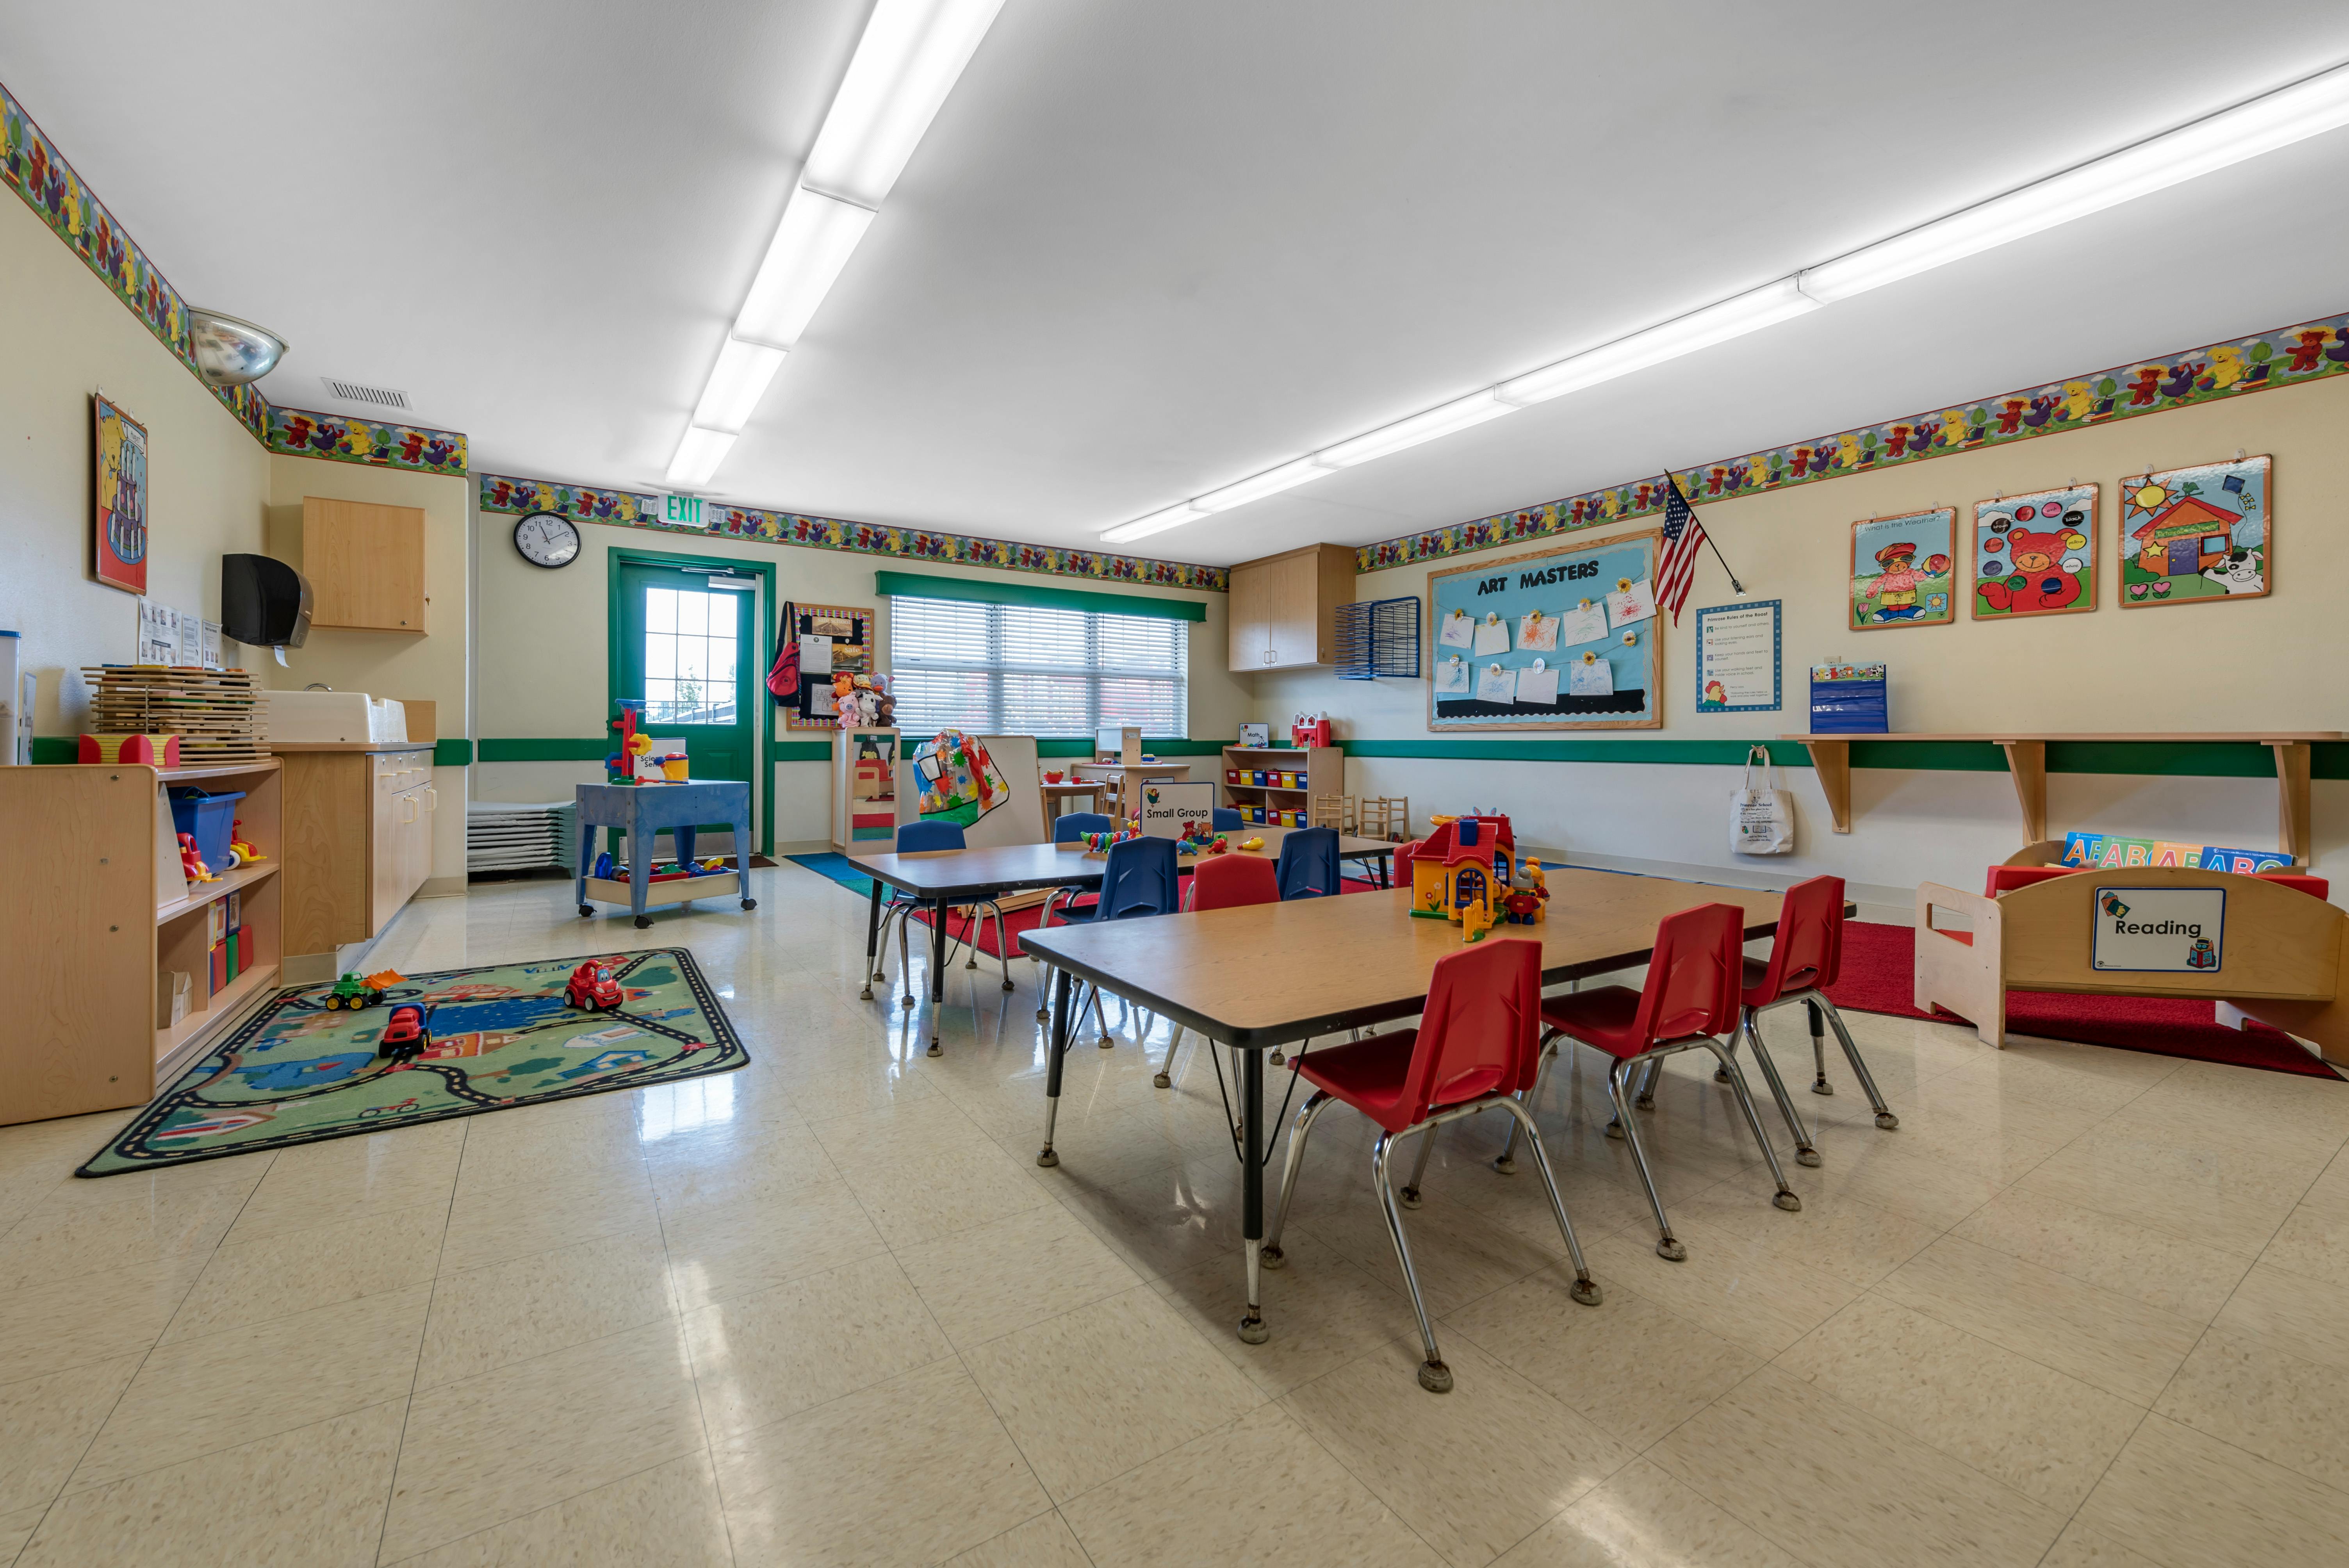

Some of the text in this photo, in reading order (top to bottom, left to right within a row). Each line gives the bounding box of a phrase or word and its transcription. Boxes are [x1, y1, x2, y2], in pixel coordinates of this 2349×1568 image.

[668, 495, 702, 523] EXIT
[1905, 516, 1941, 526] Weather?
[1477, 560, 1599, 596] ART MASTERS
[1147, 808, 1208, 819] Small Group
[2116, 920, 2201, 938] Reading
